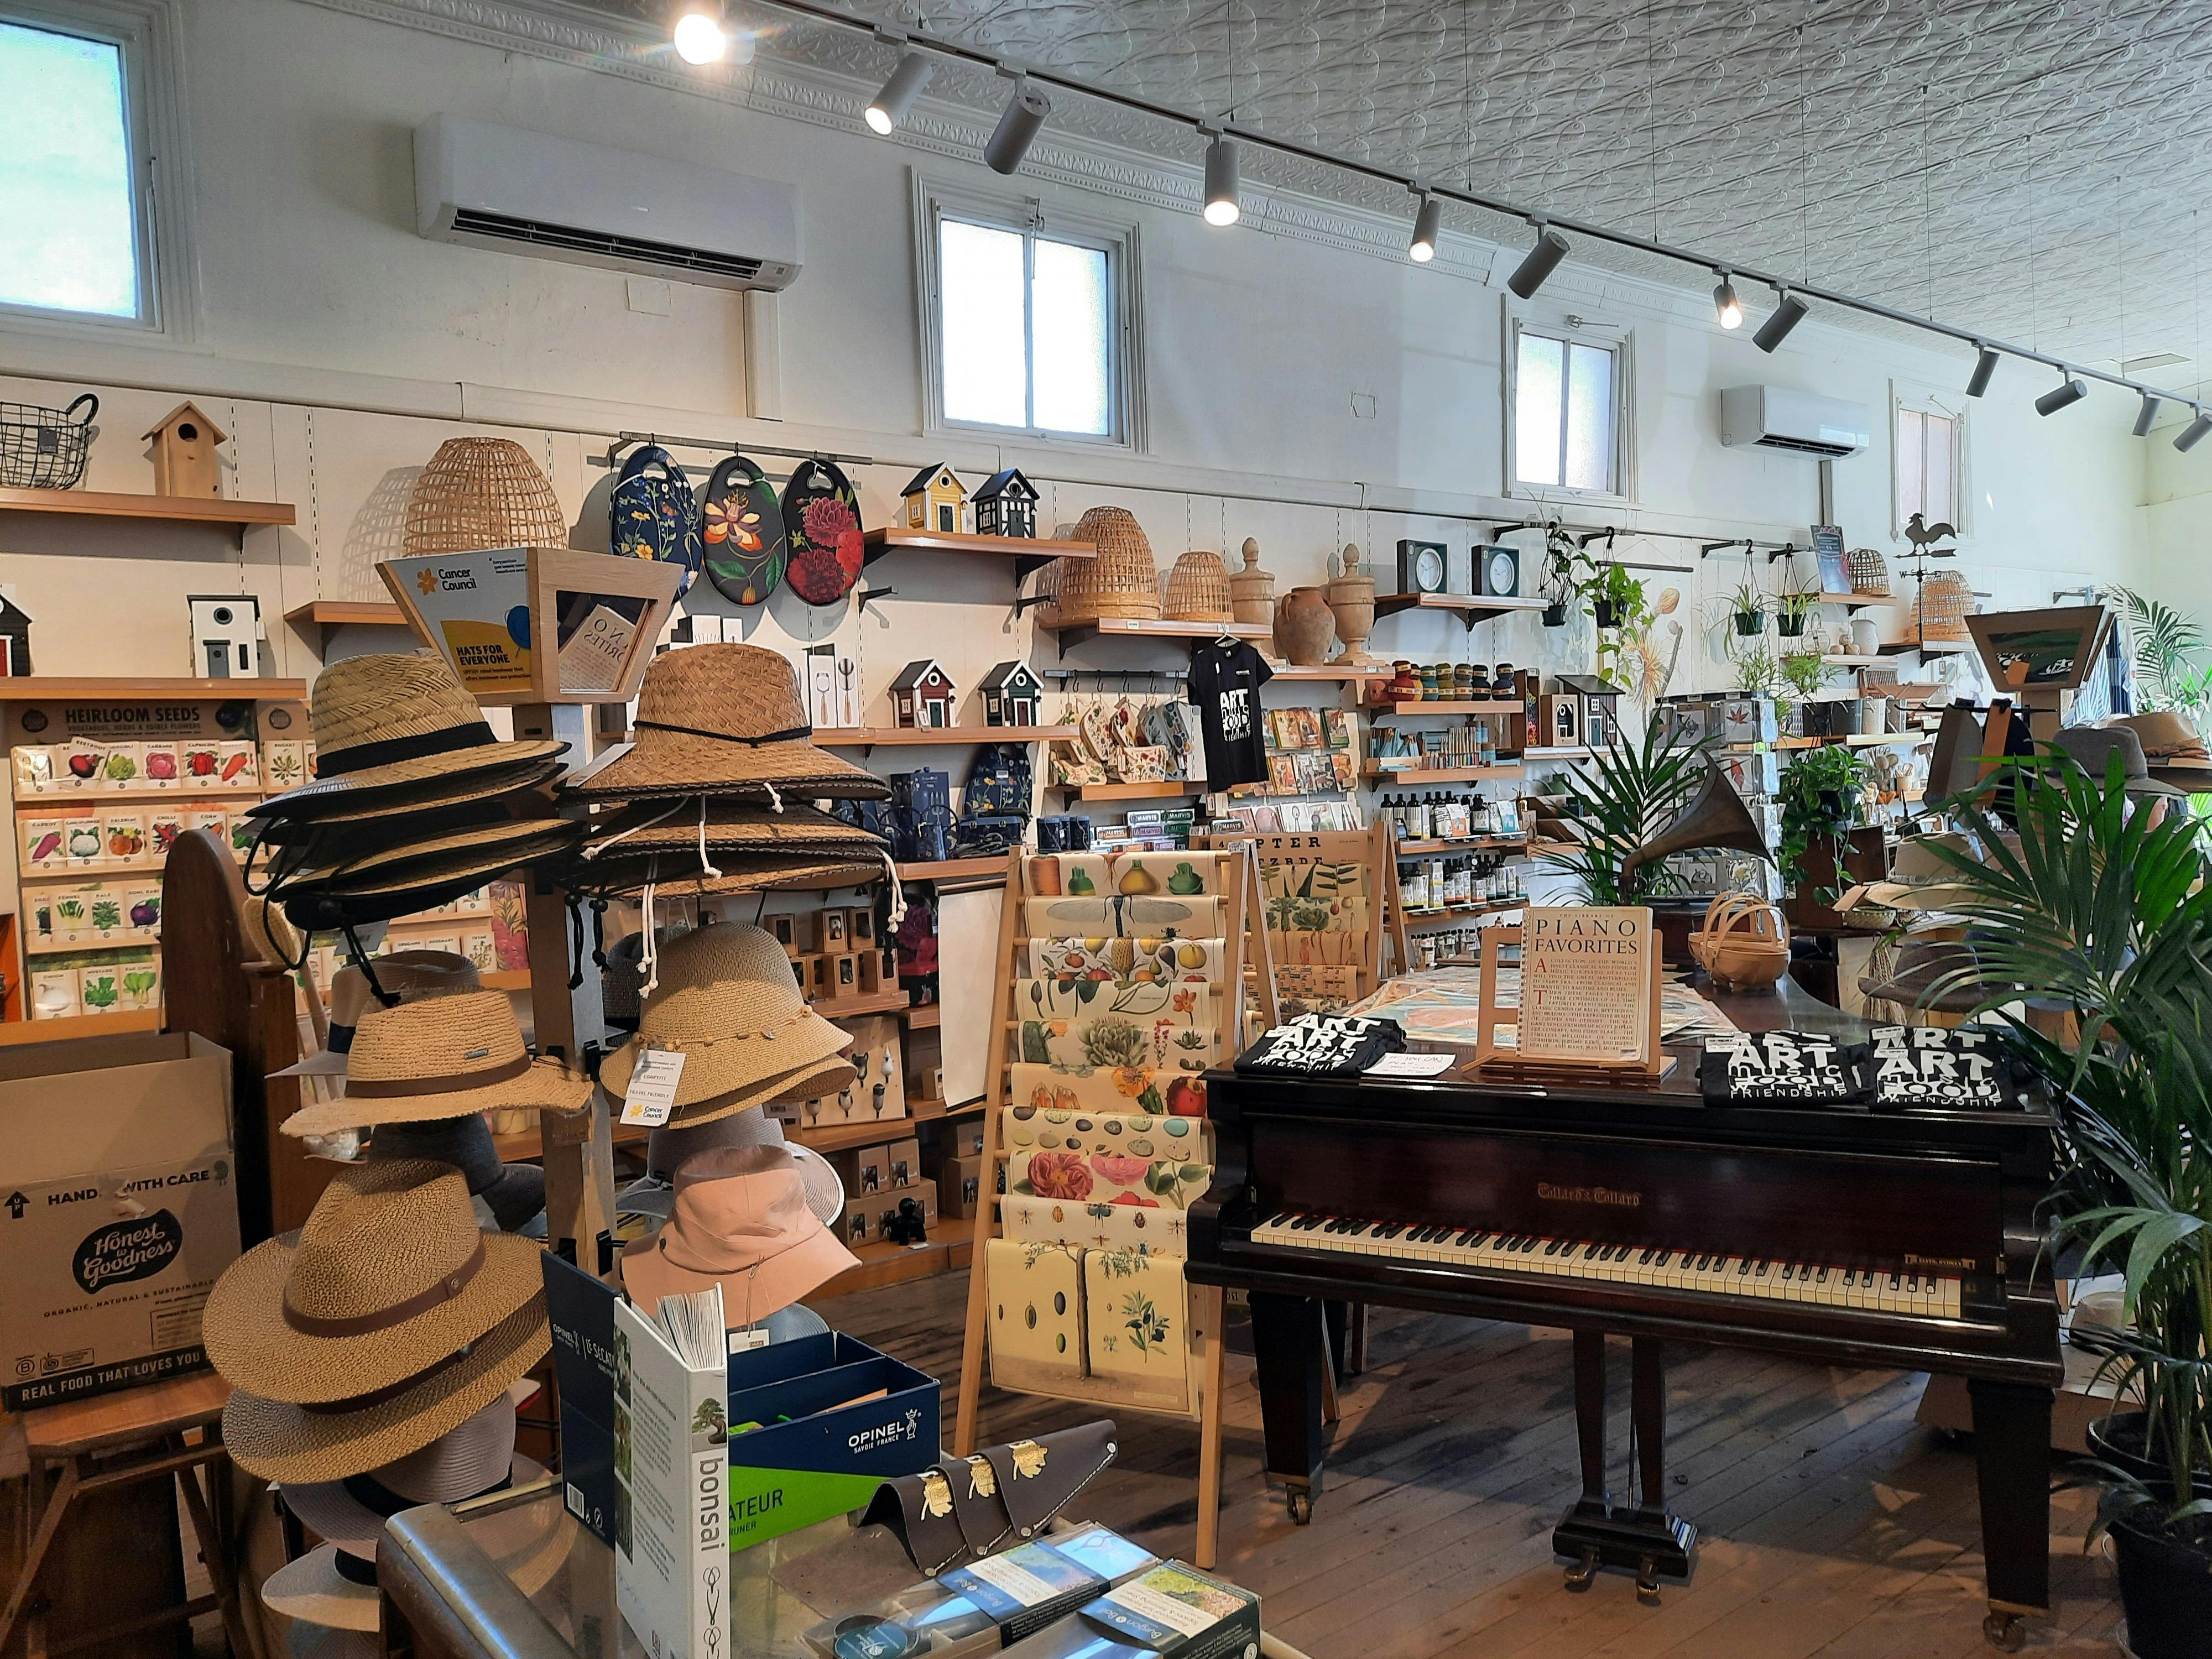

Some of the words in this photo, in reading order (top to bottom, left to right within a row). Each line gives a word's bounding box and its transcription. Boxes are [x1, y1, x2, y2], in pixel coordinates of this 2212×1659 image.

[439, 569, 471, 579] Cancer
[442, 578, 477, 591] Council
[456, 646, 482, 656] HATS
[483, 645, 503, 654] FOR
[460, 654, 510, 665] EVERYONE
[1220, 688, 1248, 710] ART
[65, 708, 150, 723] HEIRLOOM
[156, 707, 200, 722] SEEDS
[1536, 919, 1636, 937] PIANO
[1535, 939, 1637, 954] FAVORITES
[1535, 958, 1547, 973] A
[1271, 1027, 1368, 1050] ART
[1729, 1046, 1837, 1068] ART
[1877, 1050, 1994, 1081] ART
[1731, 1088, 1848, 1099] FRIENDSHIP
[167, 1170, 209, 1186] CARE
[95, 1223, 165, 1256] Honest
[84, 1241, 173, 1287] Goodness
[44, 1304, 92, 1317] ORGANIC,
[97, 1295, 139, 1307] NATURAL
[554, 1324, 574, 1343] OPINEL
[22, 1384, 55, 1401] REAL
[61, 1375, 92, 1392] FOOD
[98, 1366, 129, 1383] THAT
[134, 1358, 173, 1374] LOVES
[176, 1350, 201, 1366] YOU
[848, 1421, 904, 1447] OPINEL
[854, 1441, 874, 1454] SAVOIE
[877, 1434, 899, 1446] FRANCE
[700, 1457, 724, 1551] bonsai
[1097, 1607, 1118, 1620] Ball
[1126, 1619, 1162, 1640] Burgon
